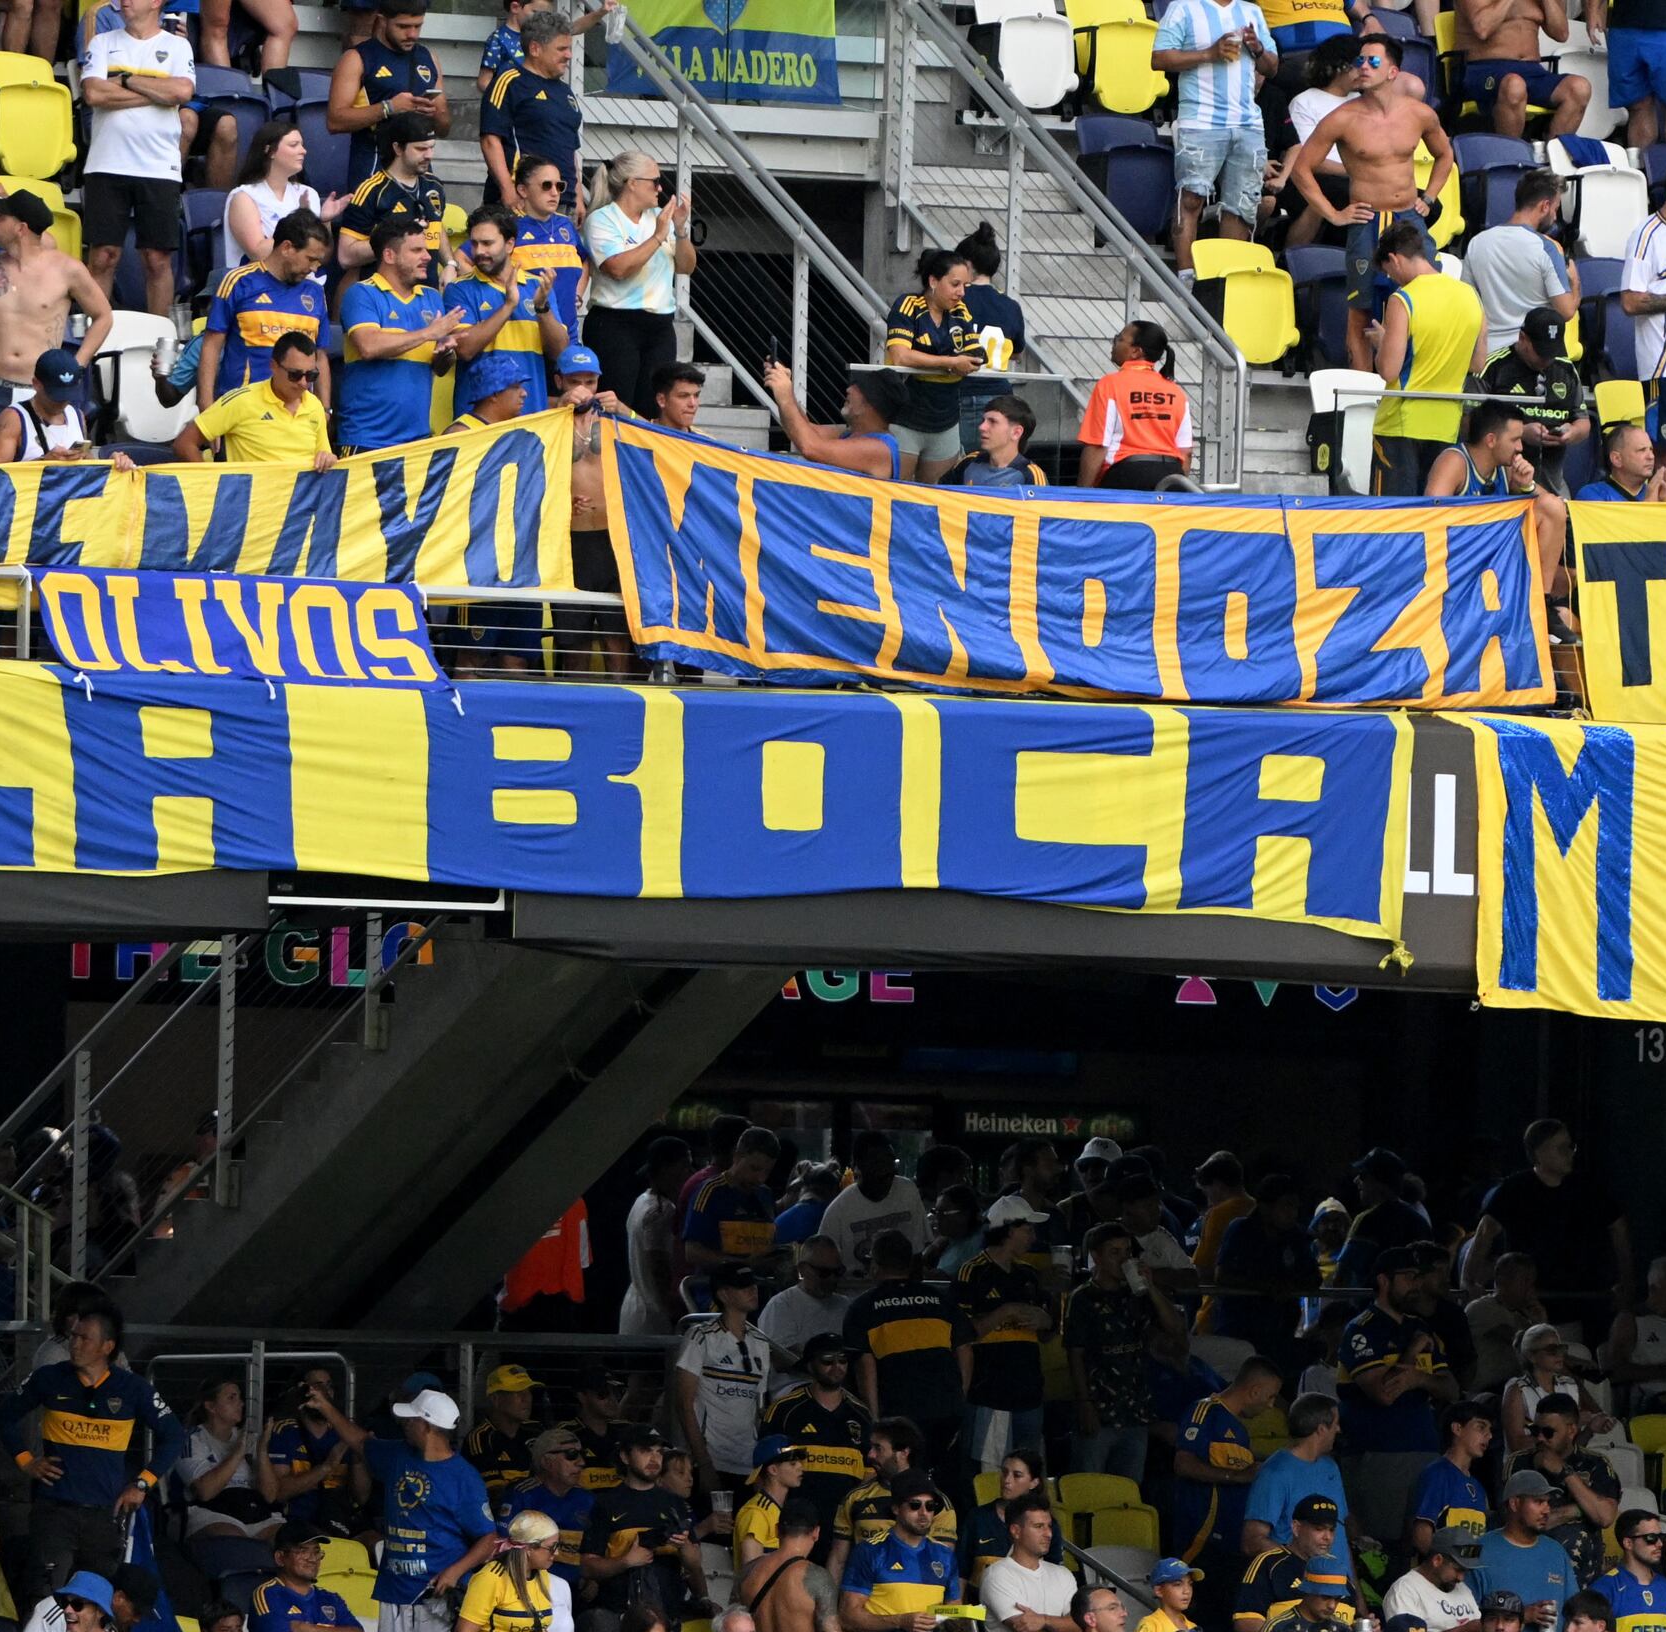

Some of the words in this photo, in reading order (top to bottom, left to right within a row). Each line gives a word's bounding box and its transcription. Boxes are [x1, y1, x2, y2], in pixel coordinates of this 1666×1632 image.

[707, 57, 817, 95] MADERO
[1128, 391, 1176, 406] BEST
[1515, 403, 1570, 420] etsson
[139, 426, 549, 590] MAYO
[601, 442, 1541, 699] MENDOZA
[40, 569, 435, 683] OLIVOS
[423, 686, 1393, 926] BOCA
[1634, 1027, 1665, 1063] 13
[964, 1111, 1058, 1133] Heineken
[873, 1295, 940, 1310] MEGATONE
[61, 1419, 111, 1437] QATAR
[805, 1452, 859, 1467] betsson
